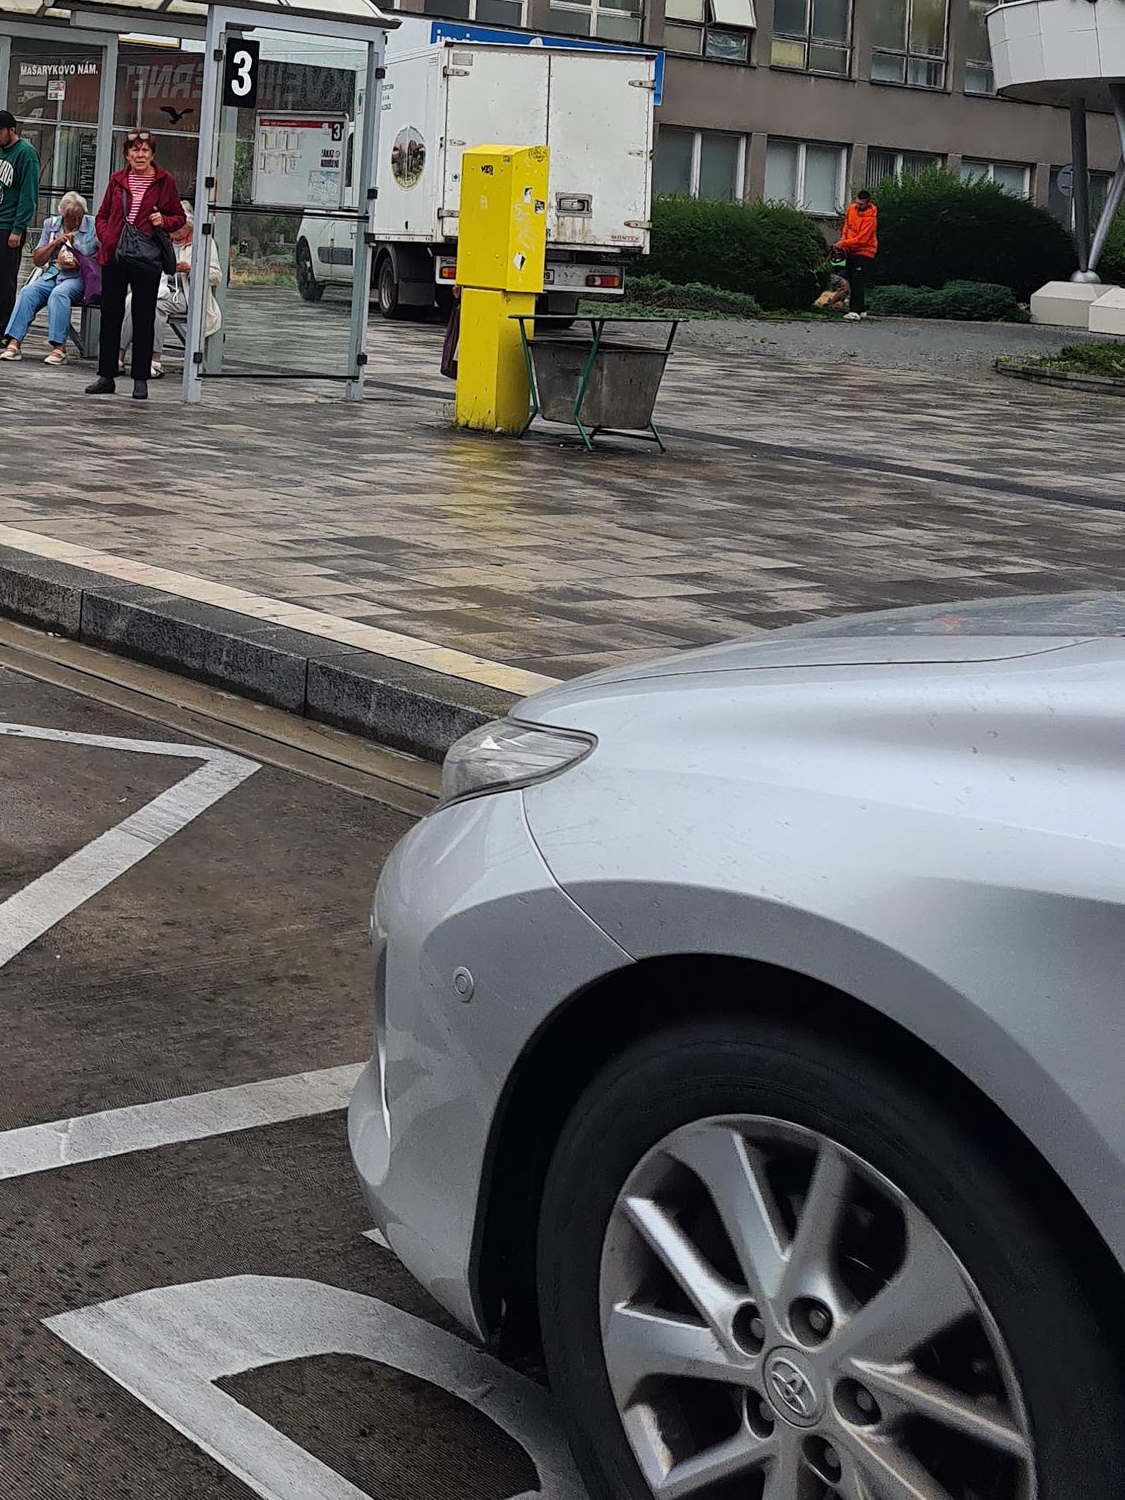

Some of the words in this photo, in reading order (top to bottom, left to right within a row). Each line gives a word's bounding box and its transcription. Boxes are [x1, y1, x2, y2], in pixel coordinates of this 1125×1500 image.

[20, 64, 76, 76] MASARYKOVO
[77, 60, 99, 75] NÁM.
[231, 50, 253, 97] 3
[333, 123, 341, 139] 3
